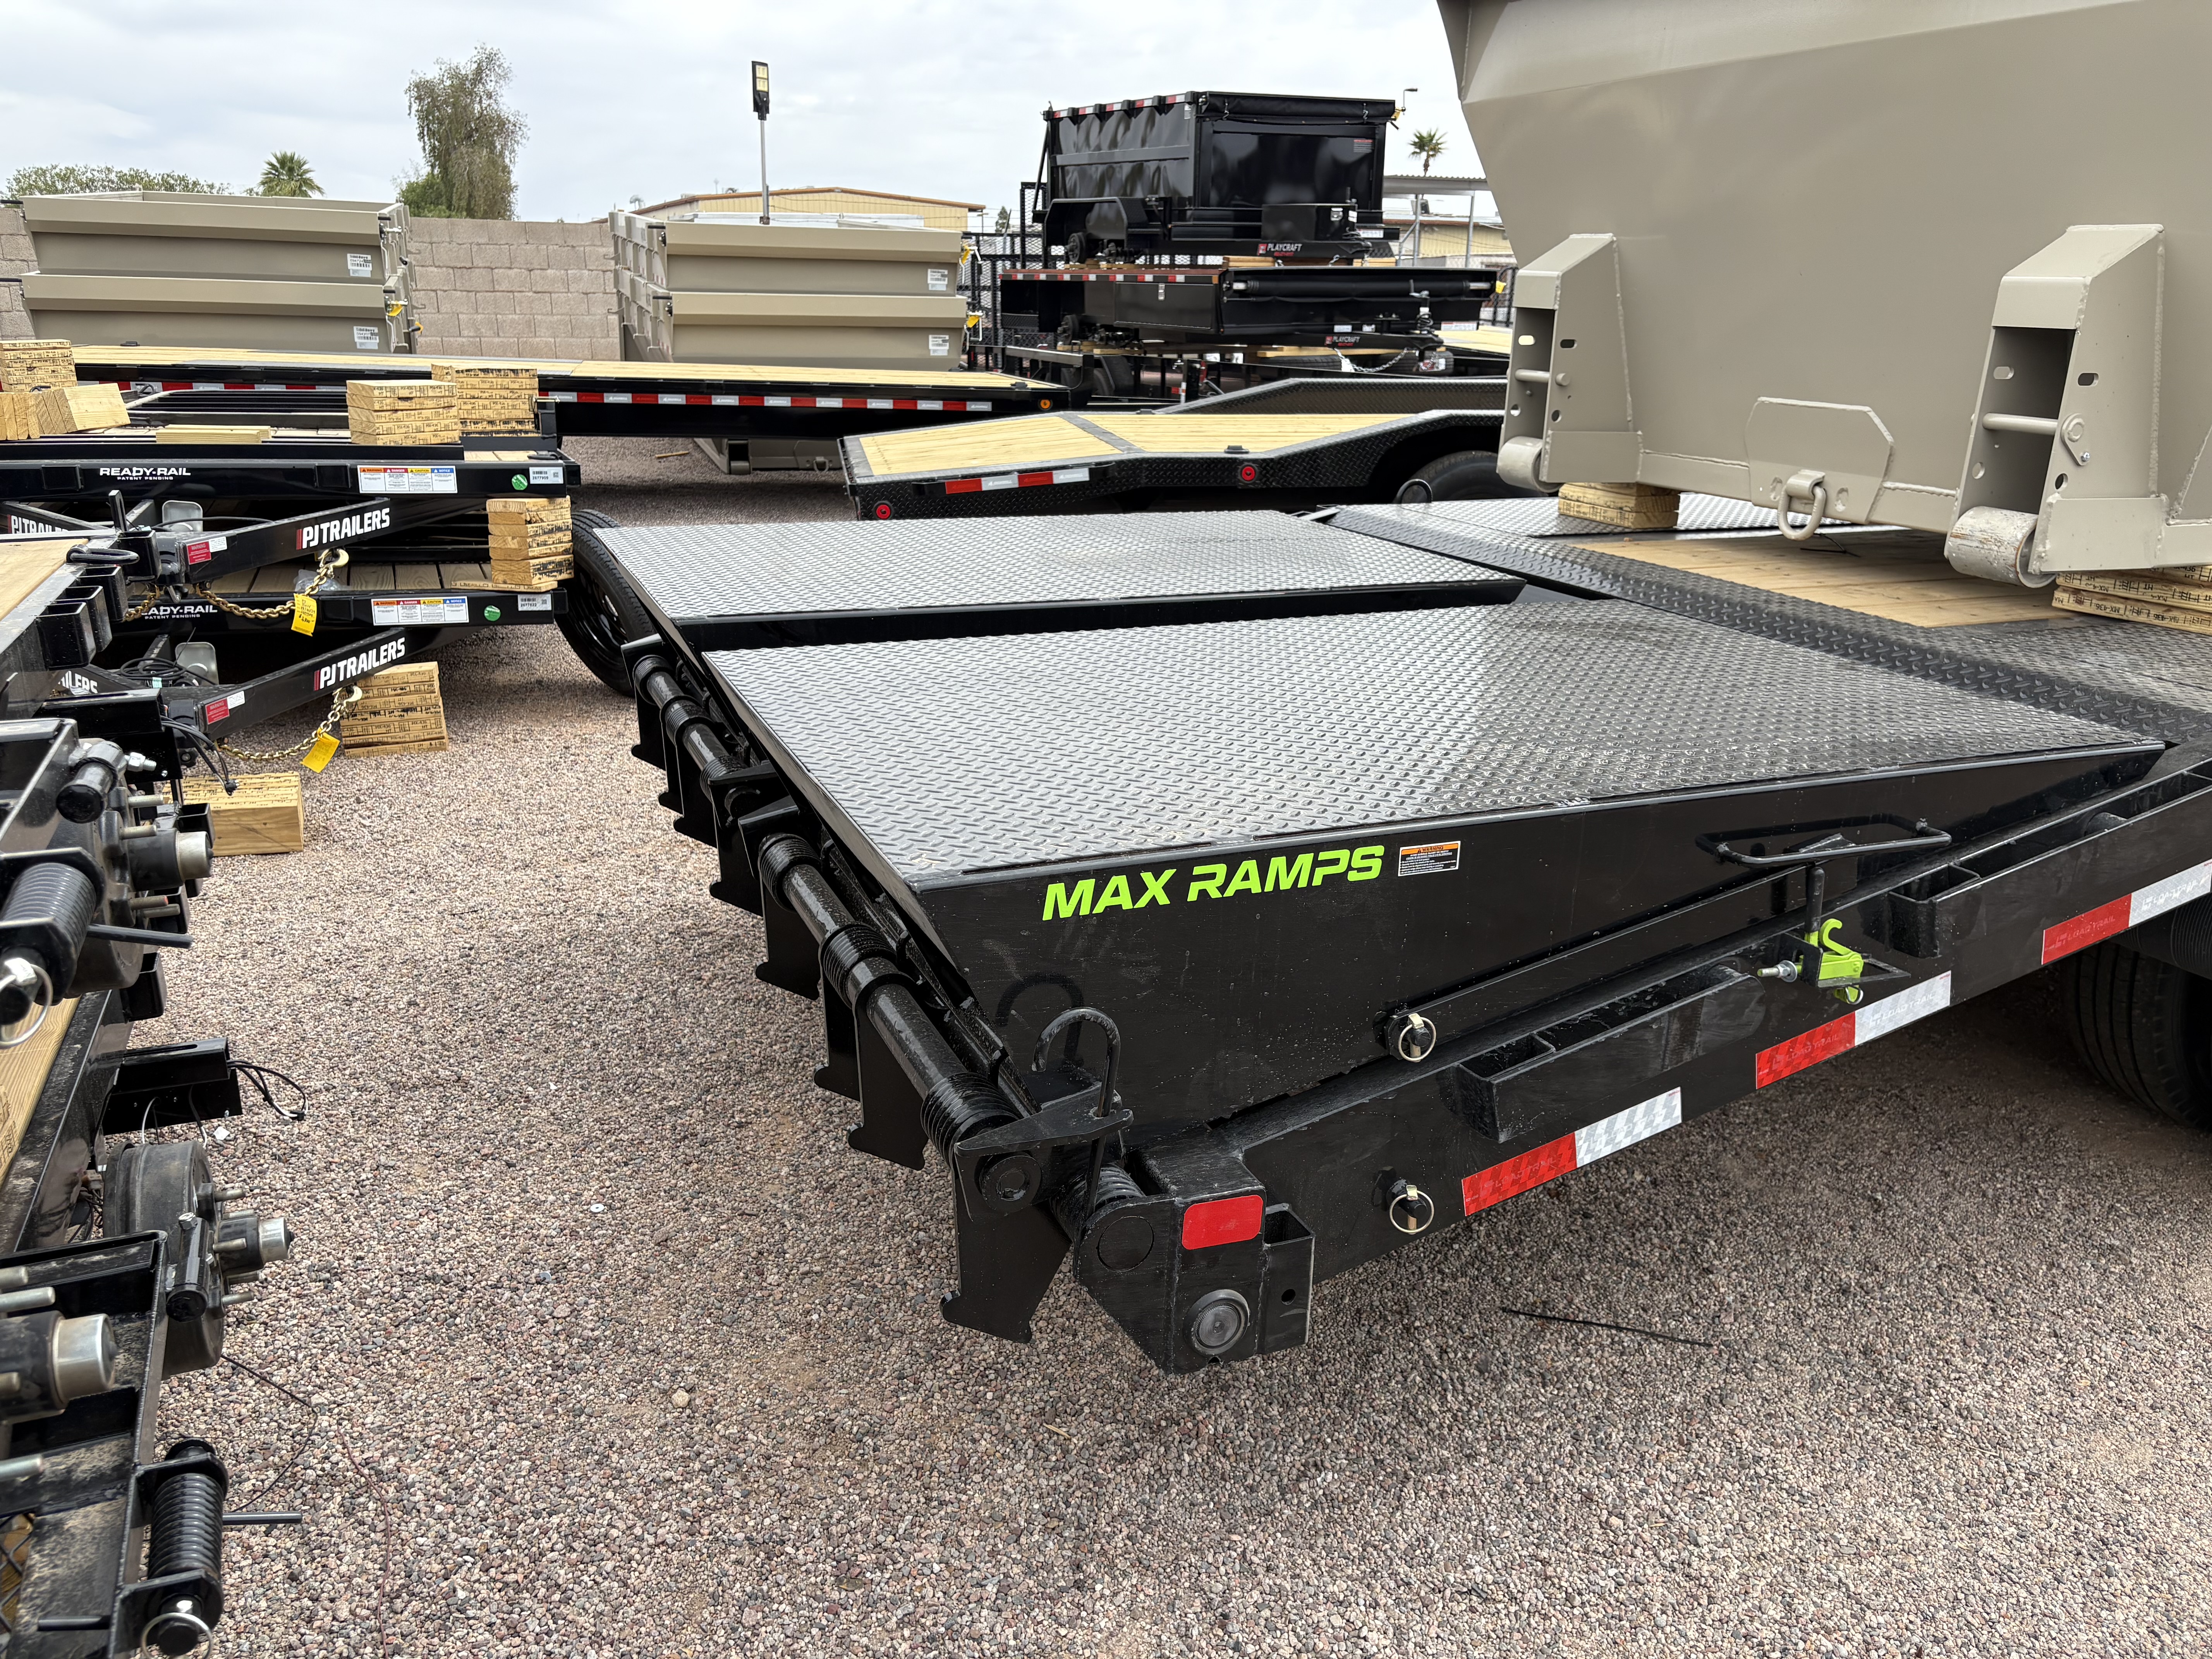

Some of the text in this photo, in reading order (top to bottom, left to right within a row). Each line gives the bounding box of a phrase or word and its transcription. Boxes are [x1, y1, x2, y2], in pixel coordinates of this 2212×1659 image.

[1267, 243, 1302, 251] PLAYCRAFT
[100, 467, 191, 476] READY-RAIL
[320, 508, 390, 544] TRAILERS
[128, 605, 217, 615] ADY-RAIL
[337, 637, 405, 682] TRAILERS
[1042, 869, 1176, 921] MAX
[1187, 845, 1385, 902] RAMPS
